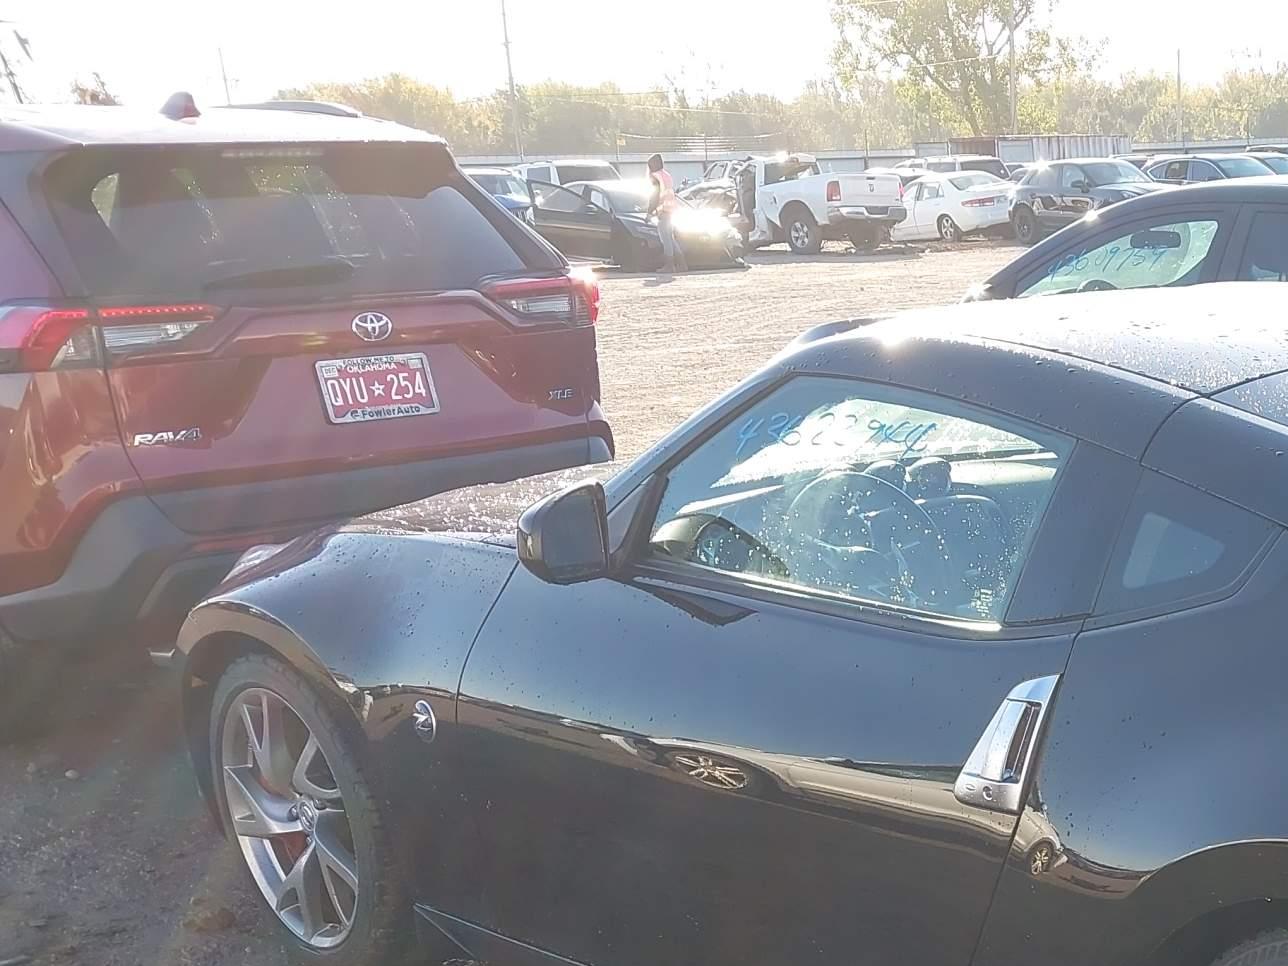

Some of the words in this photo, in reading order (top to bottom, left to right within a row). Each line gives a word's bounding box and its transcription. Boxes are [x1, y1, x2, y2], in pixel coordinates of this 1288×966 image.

[347, 363, 397, 373] OKLAHOMA
[386, 371, 426, 400] 254
[361, 405, 421, 419] FowlerAuto
[133, 427, 201, 446] RAV4
